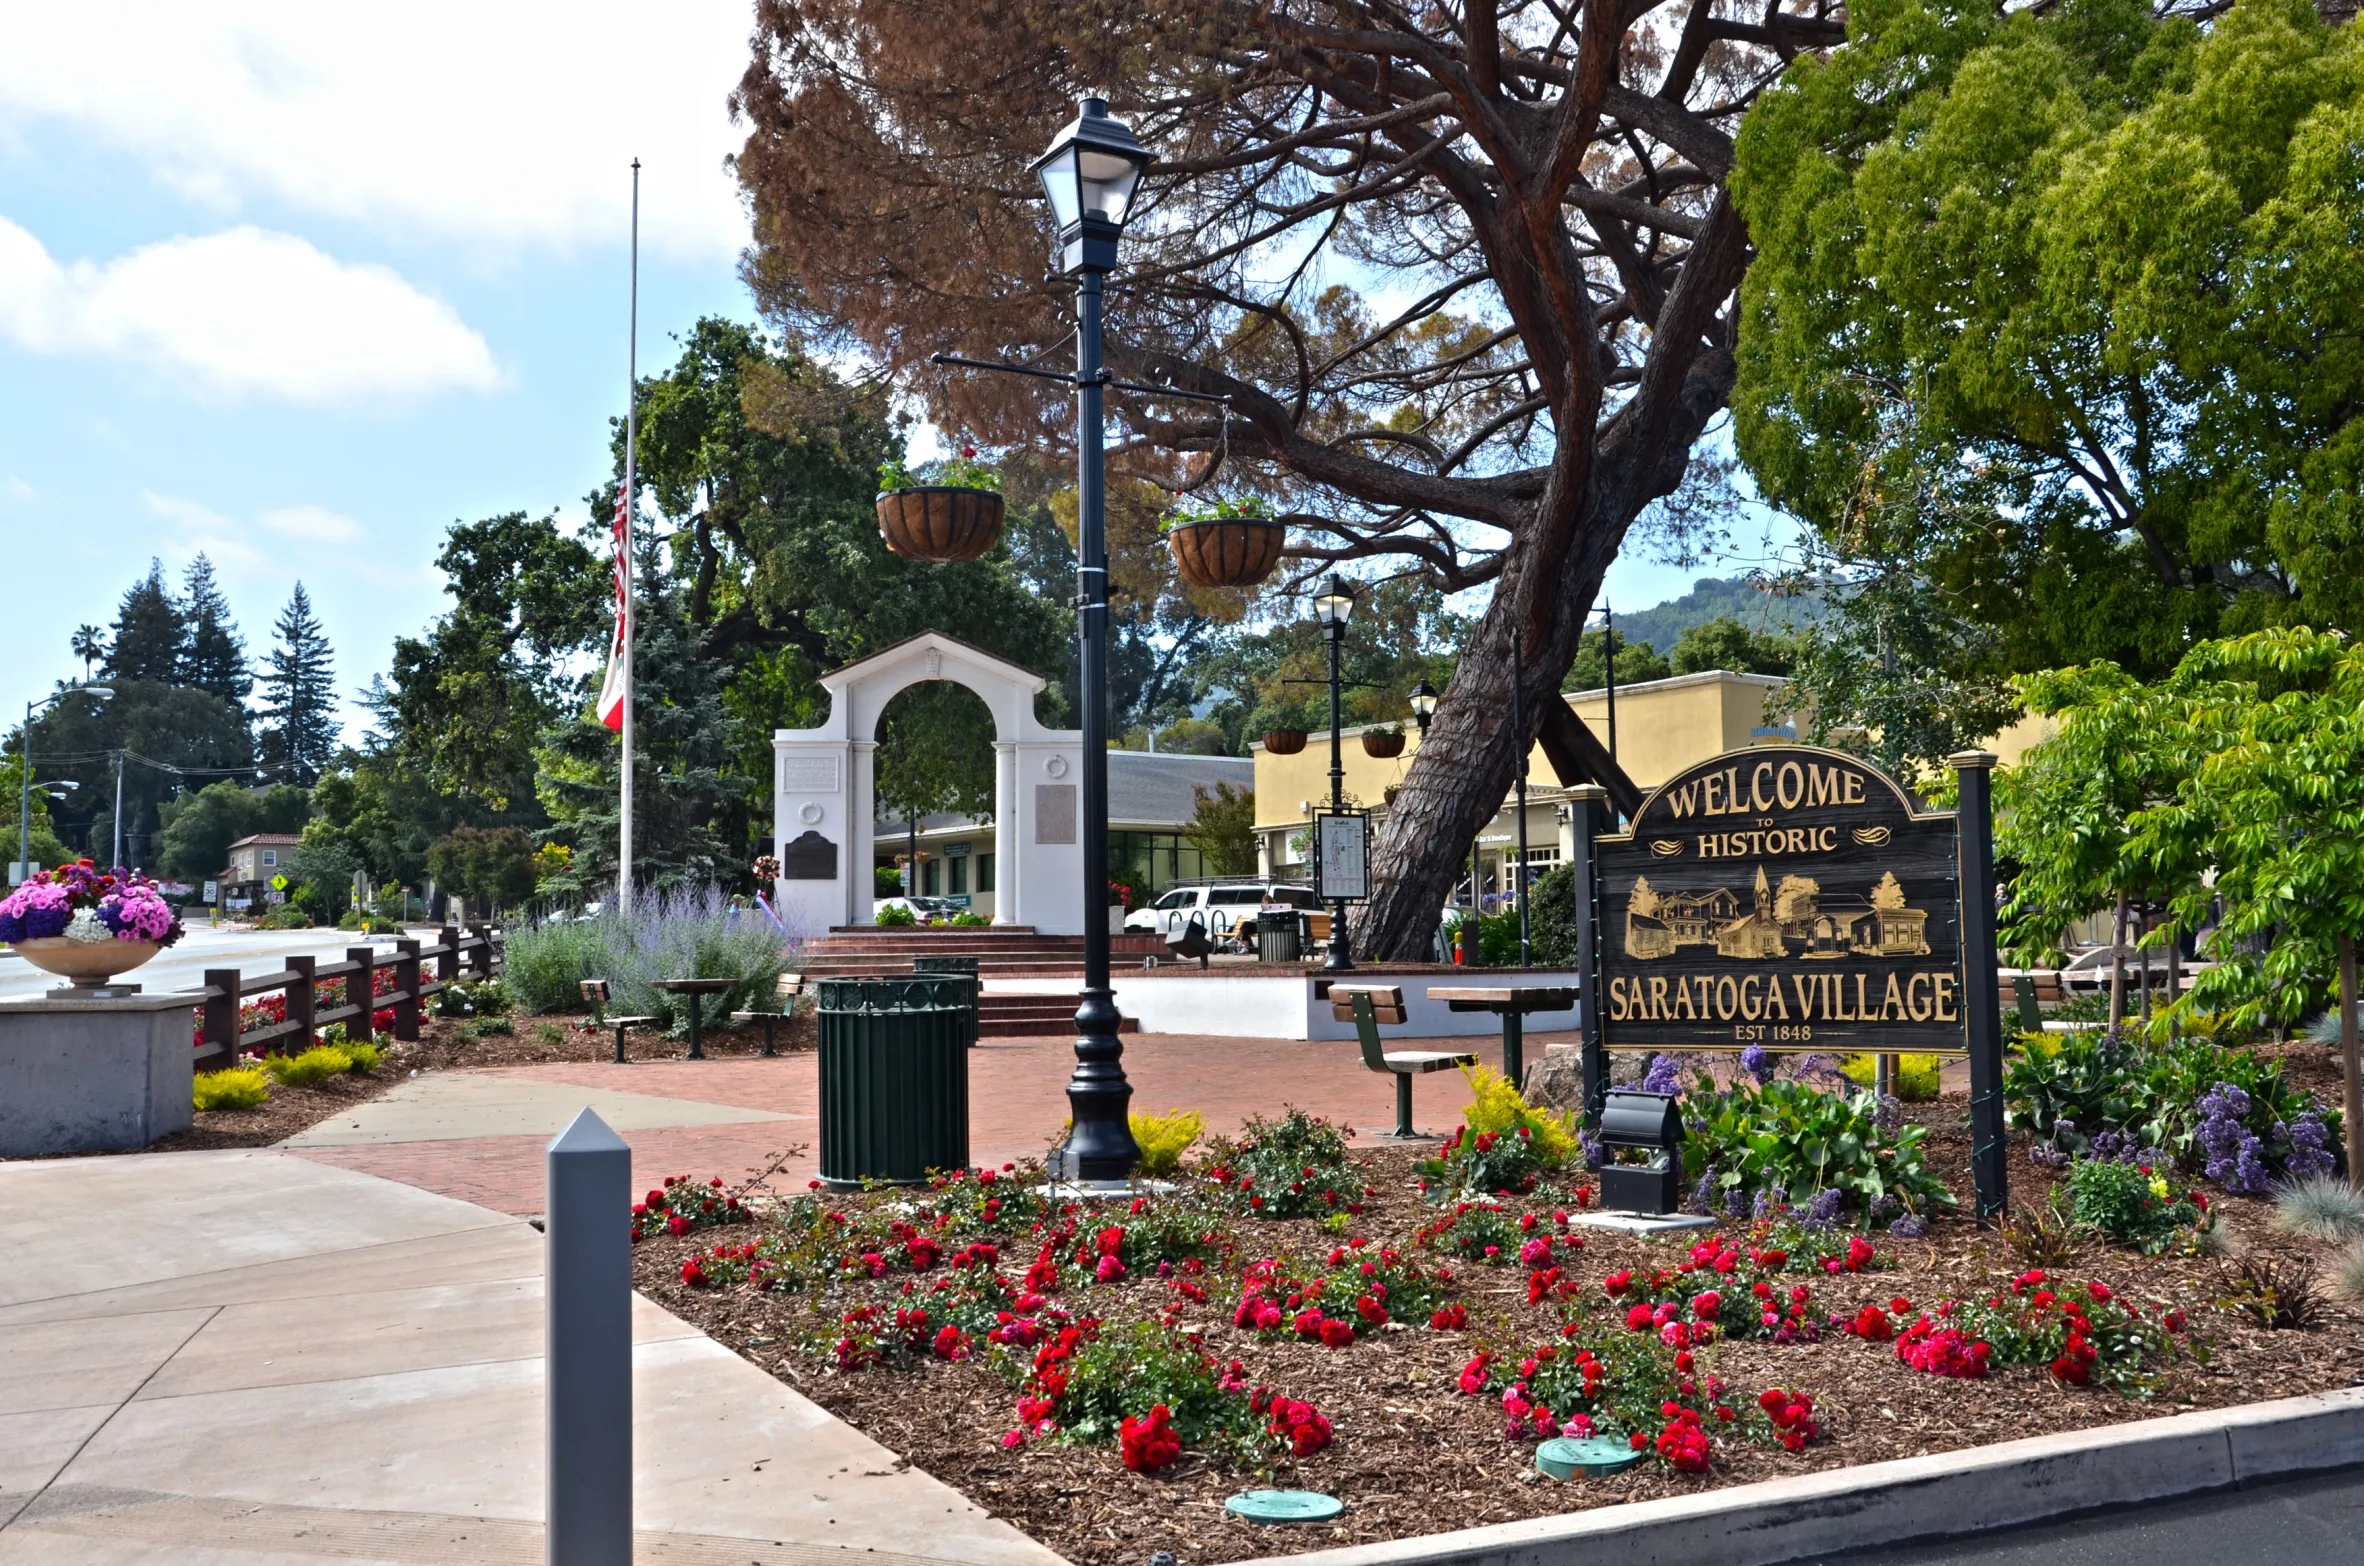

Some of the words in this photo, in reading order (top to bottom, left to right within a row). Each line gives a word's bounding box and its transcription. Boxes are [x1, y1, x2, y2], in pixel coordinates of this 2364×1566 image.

[1666, 761, 1867, 819] WELCOME
[1756, 818, 1774, 828] TO
[1697, 826, 1838, 858] HISTORIC
[1610, 973, 1790, 1021] SARATOGA
[1792, 971, 1958, 1022] VILLAGE
[1735, 1025, 1766, 1041] EST
[1773, 1025, 1812, 1041] 1848
